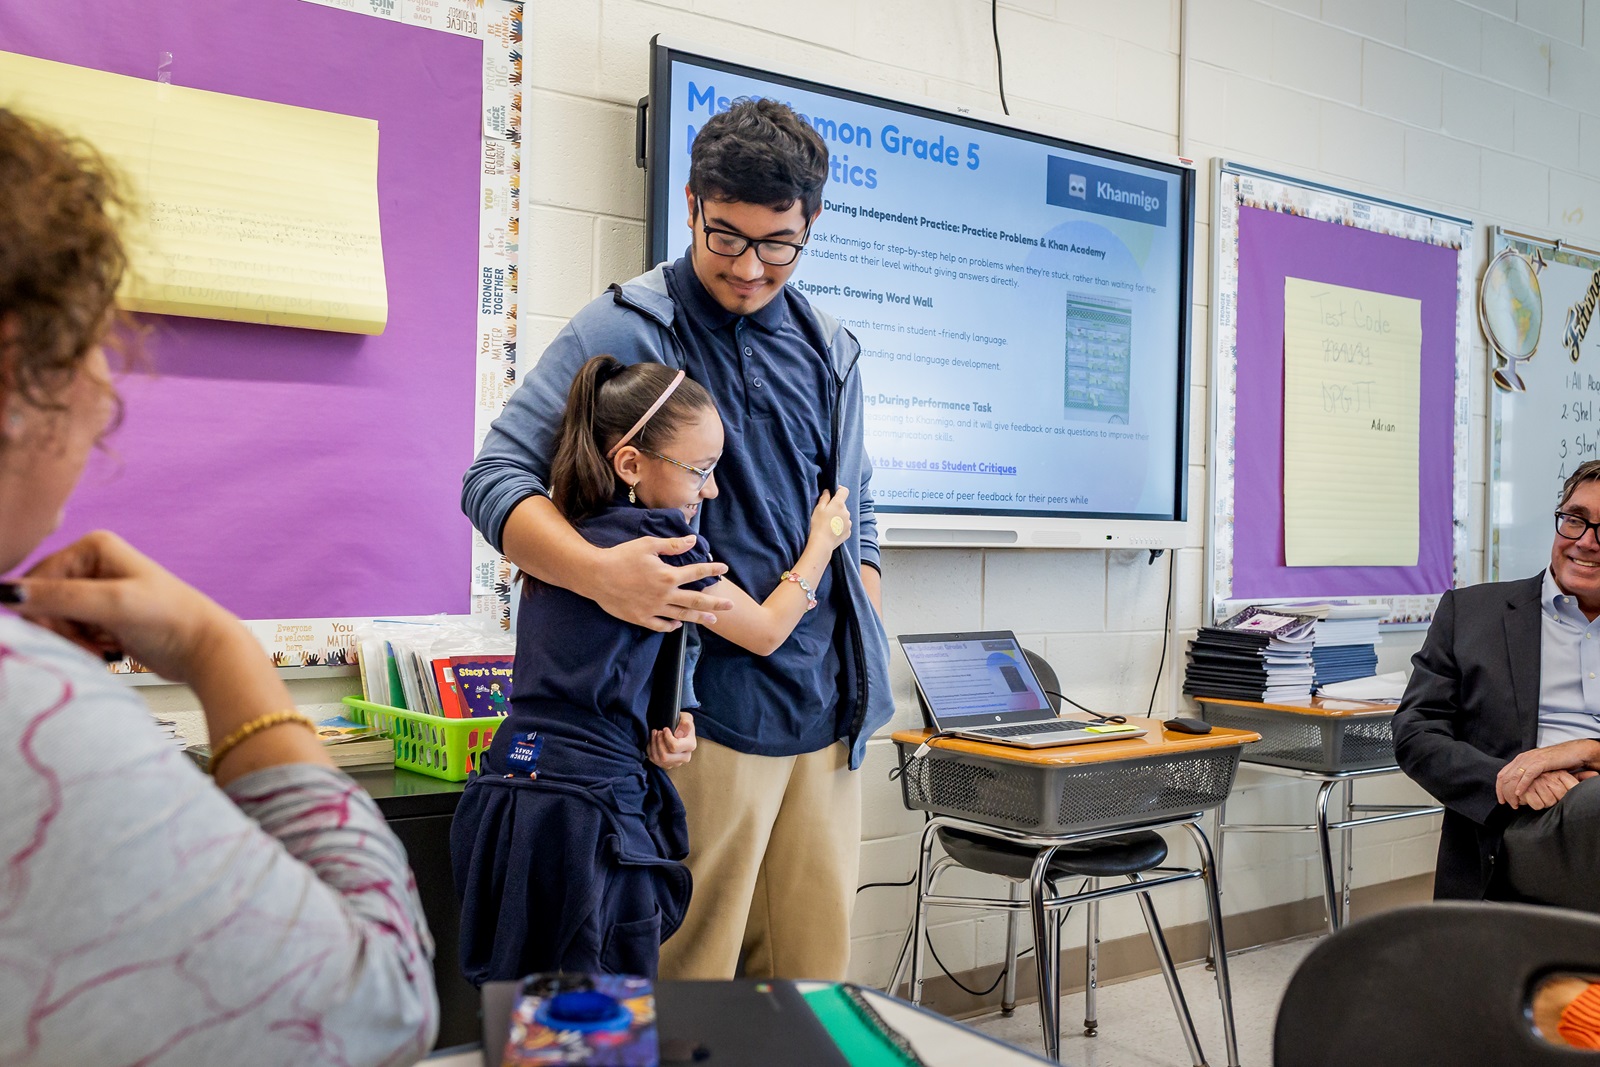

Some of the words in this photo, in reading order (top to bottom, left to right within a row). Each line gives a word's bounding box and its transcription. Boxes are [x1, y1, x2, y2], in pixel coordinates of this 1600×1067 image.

[413, 13, 433, 24] Love
[415, 5, 431, 14] one
[446, 15, 478, 35] BELIEVE
[487, 23, 495, 35] BE
[494, 22, 502, 38] THE
[501, 15, 509, 49] CHANGE
[486, 57, 496, 91] DREAM
[495, 65, 508, 88] BIG
[486, 116, 492, 126] BE
[492, 106, 500, 132] NICE
[484, 140, 496, 176] BELIEVE
[881, 124, 960, 167] Grade
[966, 142, 980, 171] 5
[484, 188, 494, 210] YOU
[1096, 181, 1160, 212] Khanmigo
[823, 199, 858, 218] During
[859, 205, 919, 226] Independent
[920, 216, 960, 233] Practice:
[961, 223, 998, 240] Practice
[999, 230, 1038, 247] Problems
[1039, 237, 1047, 248] &
[1048, 239, 1069, 252] Khan
[1069, 243, 1106, 260] Academy
[810, 247, 848, 262] students
[849, 254, 859, 264] at
[860, 254, 880, 267] their
[881, 259, 902, 270] level
[902, 261, 933, 275] without
[933, 265, 957, 280] giving
[958, 271, 990, 283] answers
[990, 273, 1020, 289] directly.
[813, 232, 828, 243] ask
[830, 233, 872, 250] Khanmigo
[873, 240, 885, 251] for
[887, 244, 938, 261] step-by-step
[940, 250, 956, 263] help
[957, 255, 968, 265] on
[969, 257, 1004, 270] problems
[1005, 262, 1025, 273] when
[1026, 265, 1050, 278] they're
[1072, 272, 1094, 284] rather
[1094, 275, 1110, 287] than
[1110, 278, 1134, 292] waiting
[1135, 282, 1145, 293] for
[1145, 285, 1157, 294] the
[482, 266, 493, 315] STRONGER
[493, 268, 504, 315] TOGETHER
[797, 279, 842, 297] Support:
[843, 286, 884, 304] Growing
[886, 291, 911, 306] Word
[912, 295, 934, 308] Wall
[1310, 291, 1347, 327] Test
[1353, 300, 1392, 335] Code
[849, 316, 871, 329] math
[872, 320, 896, 332] terms
[897, 323, 905, 333] in
[906, 325, 937, 338] student
[938, 328, 971, 343] -friendly
[972, 332, 1009, 347] language.
[481, 333, 490, 355] You
[491, 327, 503, 361] MATTER
[860, 348, 895, 361] standing
[896, 352, 912, 363] and
[913, 353, 950, 367] language
[951, 357, 1002, 371] development.
[878, 393, 910, 409] During
[912, 396, 970, 412] Performance
[972, 402, 993, 413] Task
[956, 419, 972, 429] and
[973, 419, 979, 428] it
[980, 419, 993, 429] will
[994, 422, 1010, 432] give
[1010, 422, 1043, 433] feedback
[1044, 426, 1053, 434] or
[1054, 426, 1066, 435] ask
[1067, 427, 1099, 438] questions
[1100, 429, 1107, 438] to
[1108, 430, 1134, 441] improve
[1135, 432, 1150, 441] their
[1370, 418, 1396, 433] Adrian
[879, 457, 890, 467] to
[892, 456, 904, 468] be
[905, 458, 927, 469] used
[929, 461, 940, 470] as
[941, 460, 977, 473] Student
[978, 462, 1017, 475] Critiques
[887, 488, 920, 500] specific
[921, 489, 944, 501] piece
[945, 489, 956, 500] of
[956, 491, 975, 502] peer
[977, 491, 1014, 502] feedback
[1015, 493, 1026, 502] for
[1028, 493, 1046, 503] their
[1047, 496, 1069, 505] peers
[1069, 495, 1089, 505] while
[481, 562, 489, 587] NICE
[274, 634, 283, 643] is
[284, 633, 315, 642] welcome
[277, 623, 313, 635] Everyone
[331, 622, 354, 633] You
[285, 643, 303, 652] here
[458, 667, 490, 678] Stacy's
